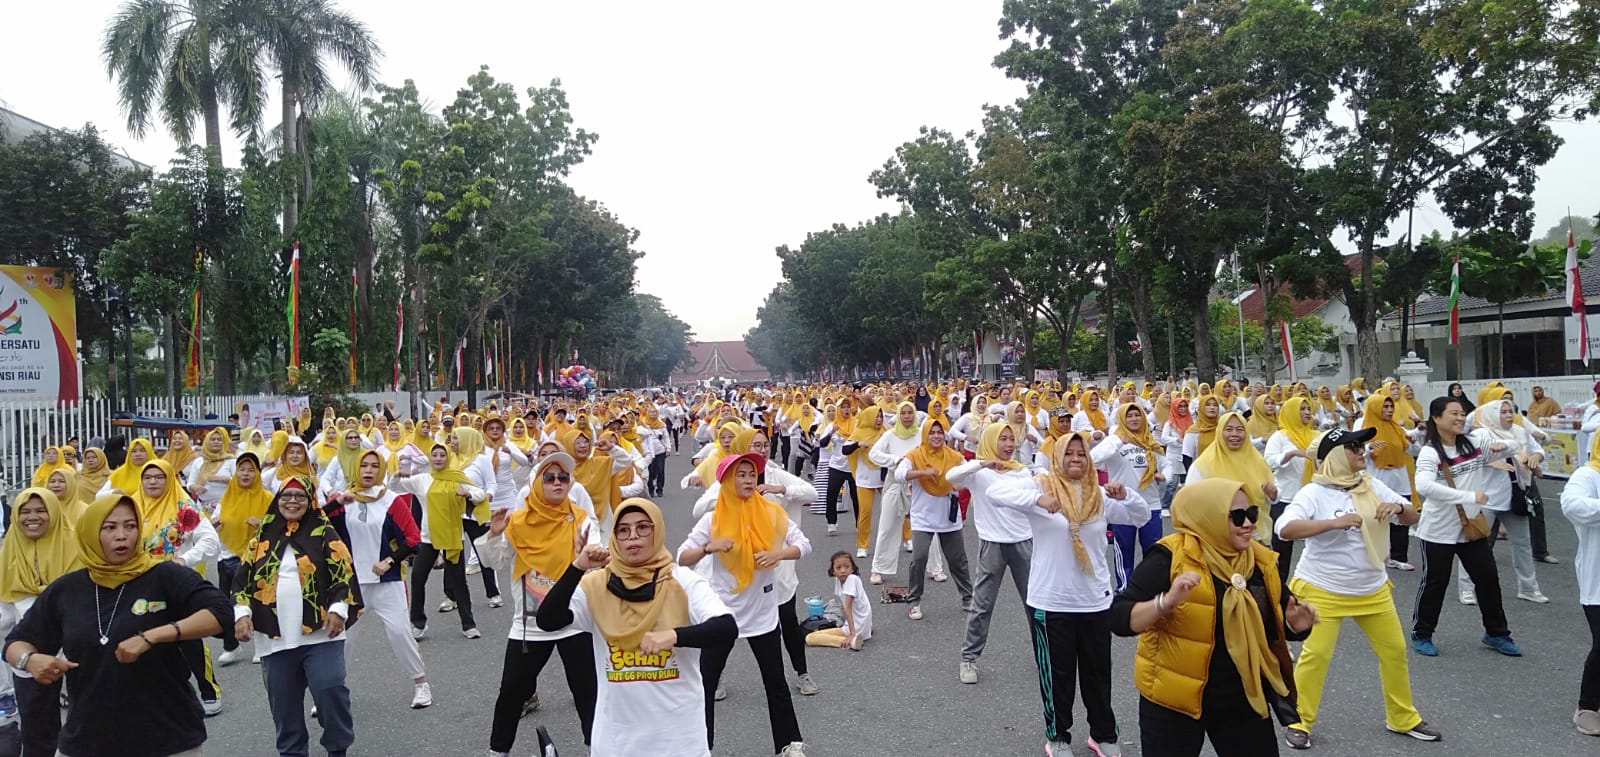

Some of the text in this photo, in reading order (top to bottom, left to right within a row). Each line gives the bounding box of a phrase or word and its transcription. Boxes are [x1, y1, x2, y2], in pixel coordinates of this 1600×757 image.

[0, 339, 40, 350] ERSATU
[18, 371, 40, 380] RIAU
[608, 671, 623, 681] HUT
[636, 671, 658, 680] PROV
[659, 669, 677, 679] RIAU
